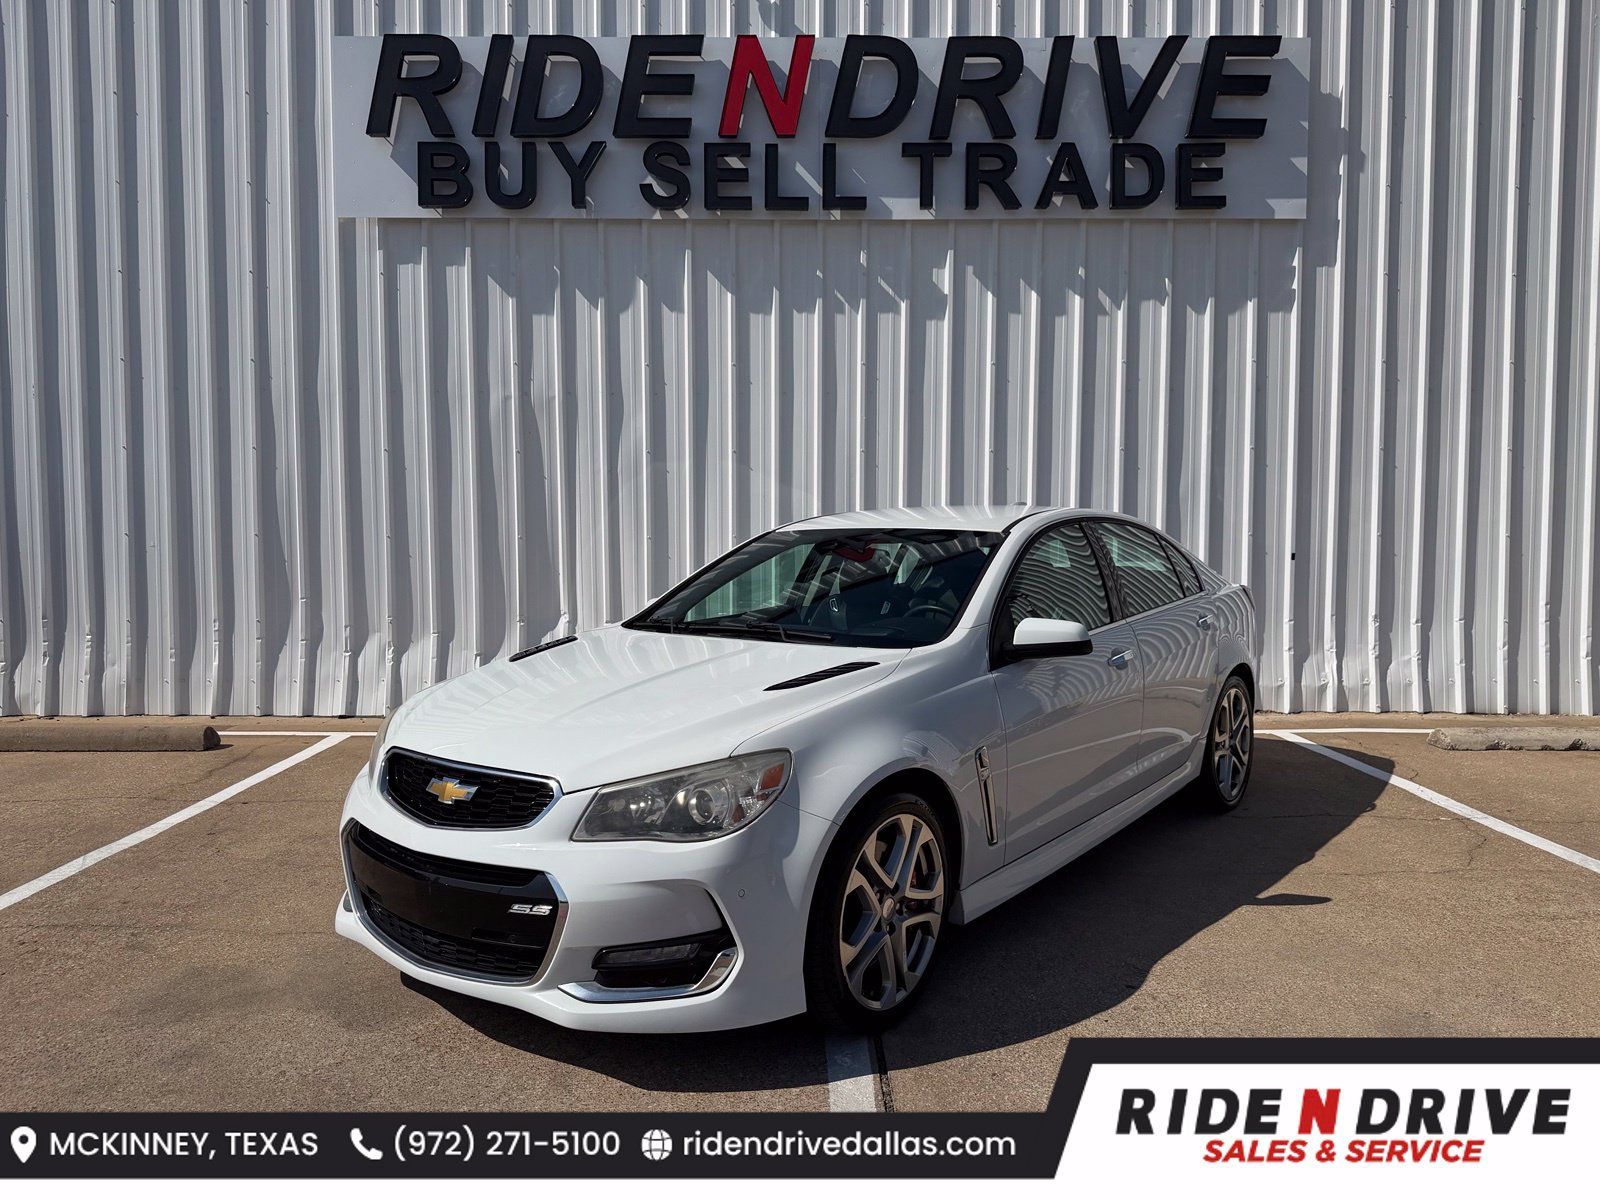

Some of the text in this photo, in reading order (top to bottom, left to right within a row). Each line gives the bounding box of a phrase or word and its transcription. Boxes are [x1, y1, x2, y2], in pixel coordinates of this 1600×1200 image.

[417, 141, 1227, 211] BUY SELL TRADE
[507, 903, 553, 916] SS
